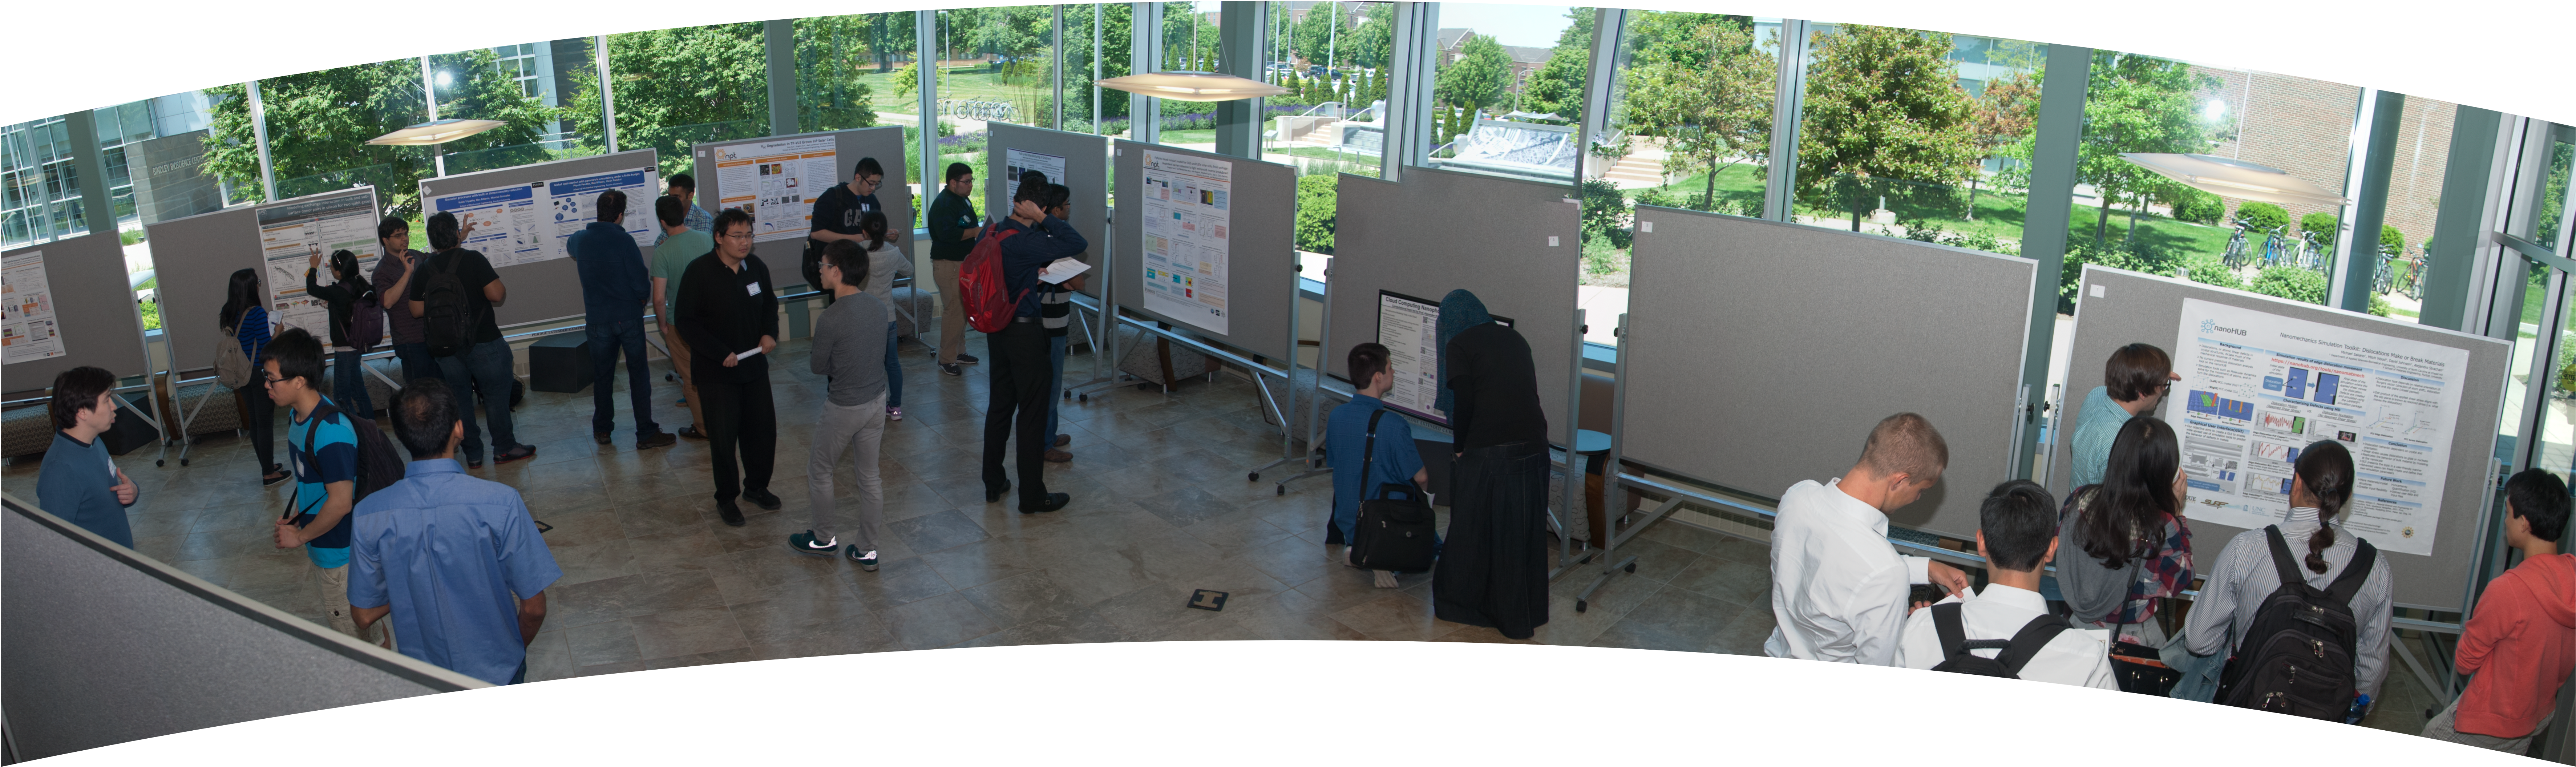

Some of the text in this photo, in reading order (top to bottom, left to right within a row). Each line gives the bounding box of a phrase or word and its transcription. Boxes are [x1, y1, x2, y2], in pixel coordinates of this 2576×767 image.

[152, 155, 205, 175] BINDLEY BIOSCIENCE CENTER
[1151, 161, 1160, 169] npt
[844, 209, 862, 227] GA
[1399, 299, 1420, 310] Computing
[1421, 304, 1439, 313] Nanopho
[2214, 326, 2247, 336] nanoHUB
[2280, 333, 2317, 343] Nanomechanics
[2318, 340, 2342, 348] Simulation
[2362, 348, 2389, 357] Dislocations
[2271, 358, 2365, 378] https://nanohub.org/tools/nanomatmech
[1403, 415, 1419, 424] PURDUE
[1420, 421, 1441, 431] EXTENDED
